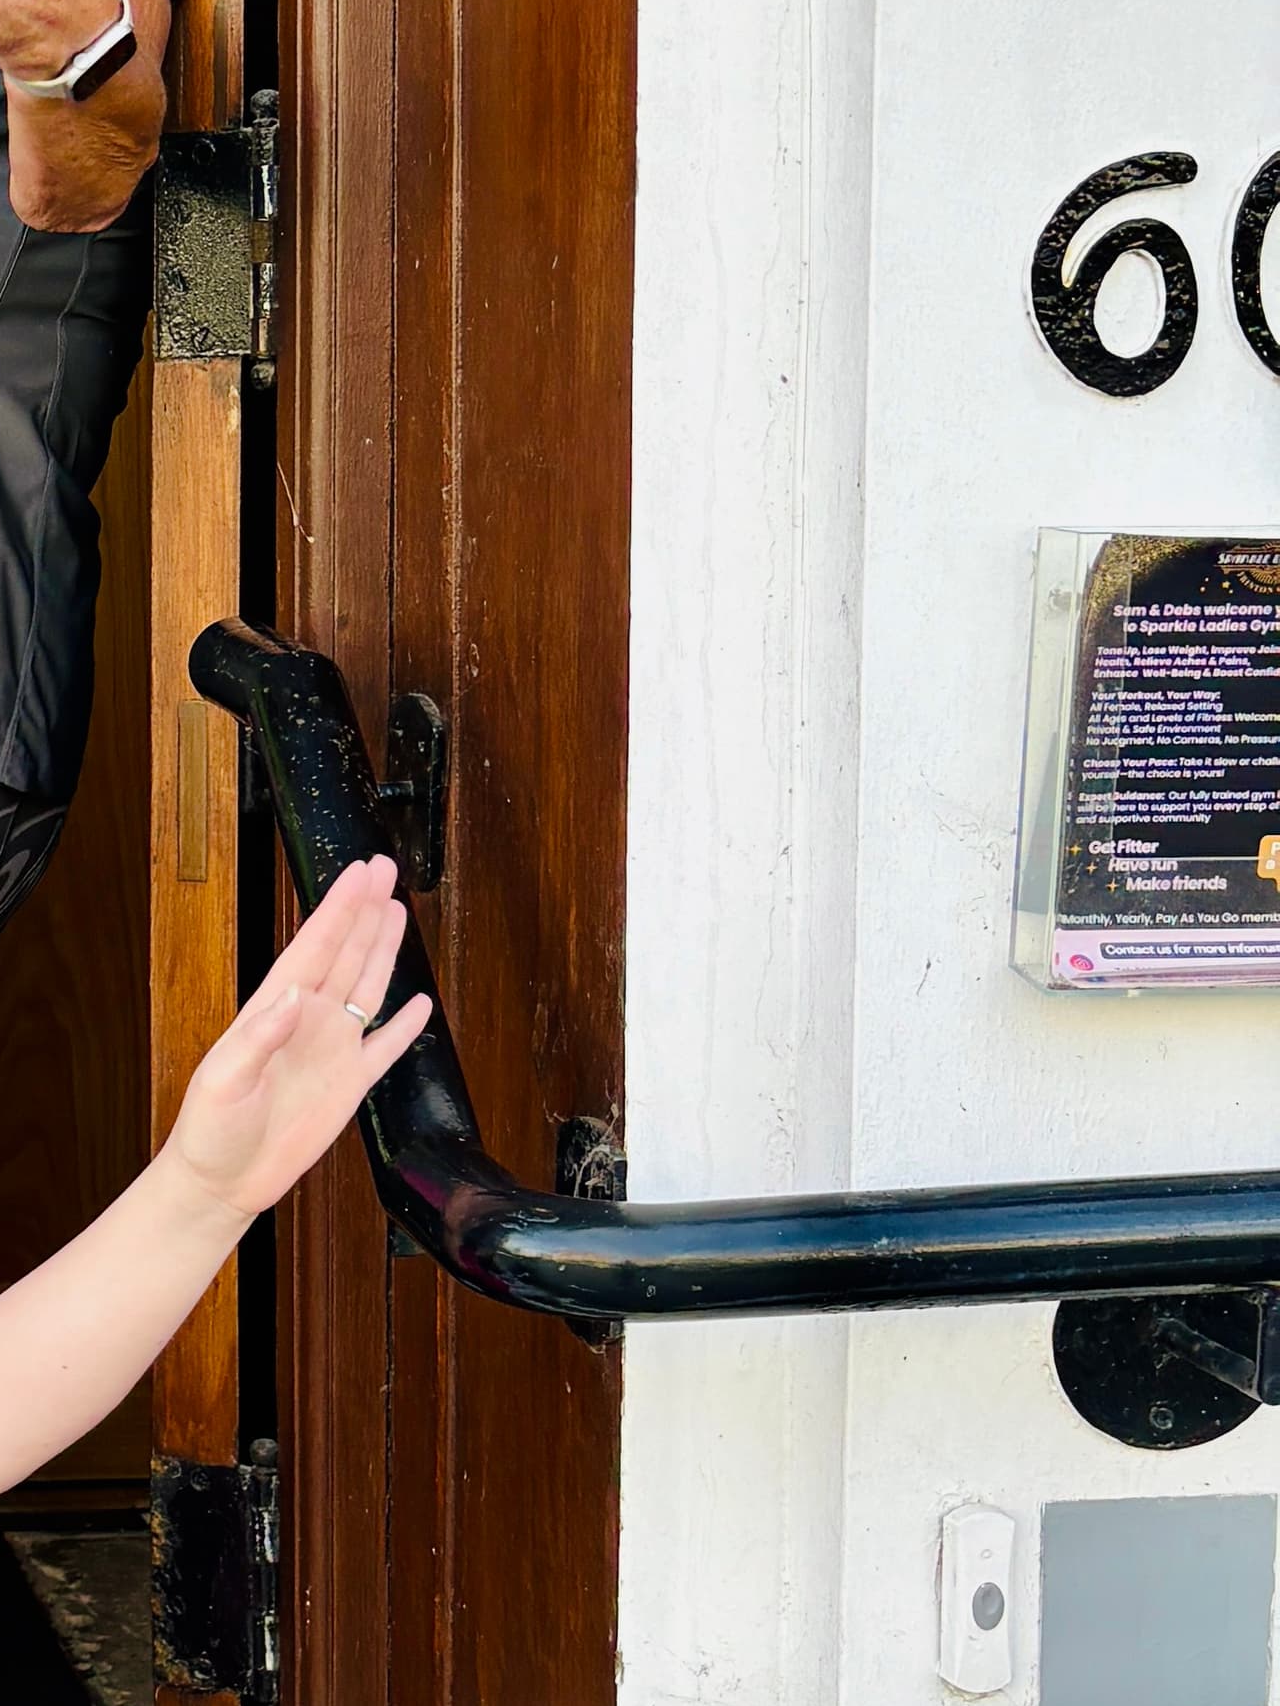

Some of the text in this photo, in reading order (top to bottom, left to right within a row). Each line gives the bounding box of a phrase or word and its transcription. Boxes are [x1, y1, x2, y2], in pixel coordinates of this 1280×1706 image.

[1113, 604, 1147, 617] Sam
[1149, 603, 1160, 617] &
[1163, 603, 1201, 616] Debs
[1203, 602, 1273, 616] welcome
[1123, 621, 1138, 633] to
[1139, 619, 1197, 636] Sparkle
[1199, 619, 1247, 632] Ladies
[1097, 646, 1123, 656] Tone
[1142, 645, 1166, 655] Lose
[1168, 645, 1209, 657] Weight,
[1210, 645, 1256, 656] Improve
[1133, 657, 1172, 666] Relieve
[1173, 657, 1207, 666] Aches
[1208, 657, 1217, 665] &
[1218, 655, 1251, 666] Pains,
[1093, 669, 1138, 678] Enhance
[1142, 668, 1202, 680] Well-Being
[1202, 668, 1211, 677] &
[1212, 668, 1243, 677] Boost
[1091, 691, 1221, 701] Your Workout, Your Way:
[1089, 701, 1224, 713] All Female, Relaxed Setting
[1088, 714, 1101, 723] All
[1102, 714, 1127, 725] Ages
[1128, 714, 1150, 723] and
[1151, 713, 1183, 723] Levels
[1184, 713, 1195, 722] of
[1196, 713, 1233, 722] Fitness
[1087, 724, 1222, 734] Private & Safe Environment
[1086, 737, 1100, 745] No
[1156, 736, 1171, 745] No
[1172, 736, 1223, 745] Cameras,
[1224, 735, 1239, 744] No
[1083, 758, 1121, 768] Choose
[1122, 758, 1147, 767] Your
[1148, 757, 1178, 767] Pace:
[1179, 757, 1203, 766] Take
[1204, 757, 1212, 765] it
[1213, 757, 1237, 766] slow
[1238, 758, 1251, 766] or
[1146, 769, 1181, 778] choice
[1182, 768, 1191, 777] is
[1193, 768, 1225, 780] yours!
[1078, 792, 1112, 802] Expert
[1112, 791, 1166, 800] Guidance:
[1168, 791, 1188, 800] Our
[1189, 790, 1211, 801] fully
[1212, 790, 1250, 799] trained
[1251, 791, 1275, 801] gym
[1077, 804, 1094, 813] will
[1095, 804, 1109, 812] be
[1113, 803, 1136, 812] here
[1138, 803, 1149, 811] to
[1150, 803, 1191, 813] support
[1192, 803, 1212, 813] you
[1213, 803, 1242, 813] every
[1243, 803, 1267, 813] step
[1076, 813, 1211, 825] and supportive community
[1088, 838, 1159, 854] Get Fitter
[1108, 858, 1151, 872] Have
[1125, 875, 1228, 891] Make friends
[1060, 913, 1113, 927] Monthly,
[1115, 913, 1154, 925] Yearly,
[1155, 913, 1179, 925] Pay
[1180, 913, 1194, 923] As
[1197, 913, 1220, 923] You
[1222, 912, 1240, 923] Go
[1105, 944, 1155, 955] Contact
[1157, 944, 1172, 954] us
[1173, 943, 1190, 954] for
[1193, 945, 1227, 954] more
